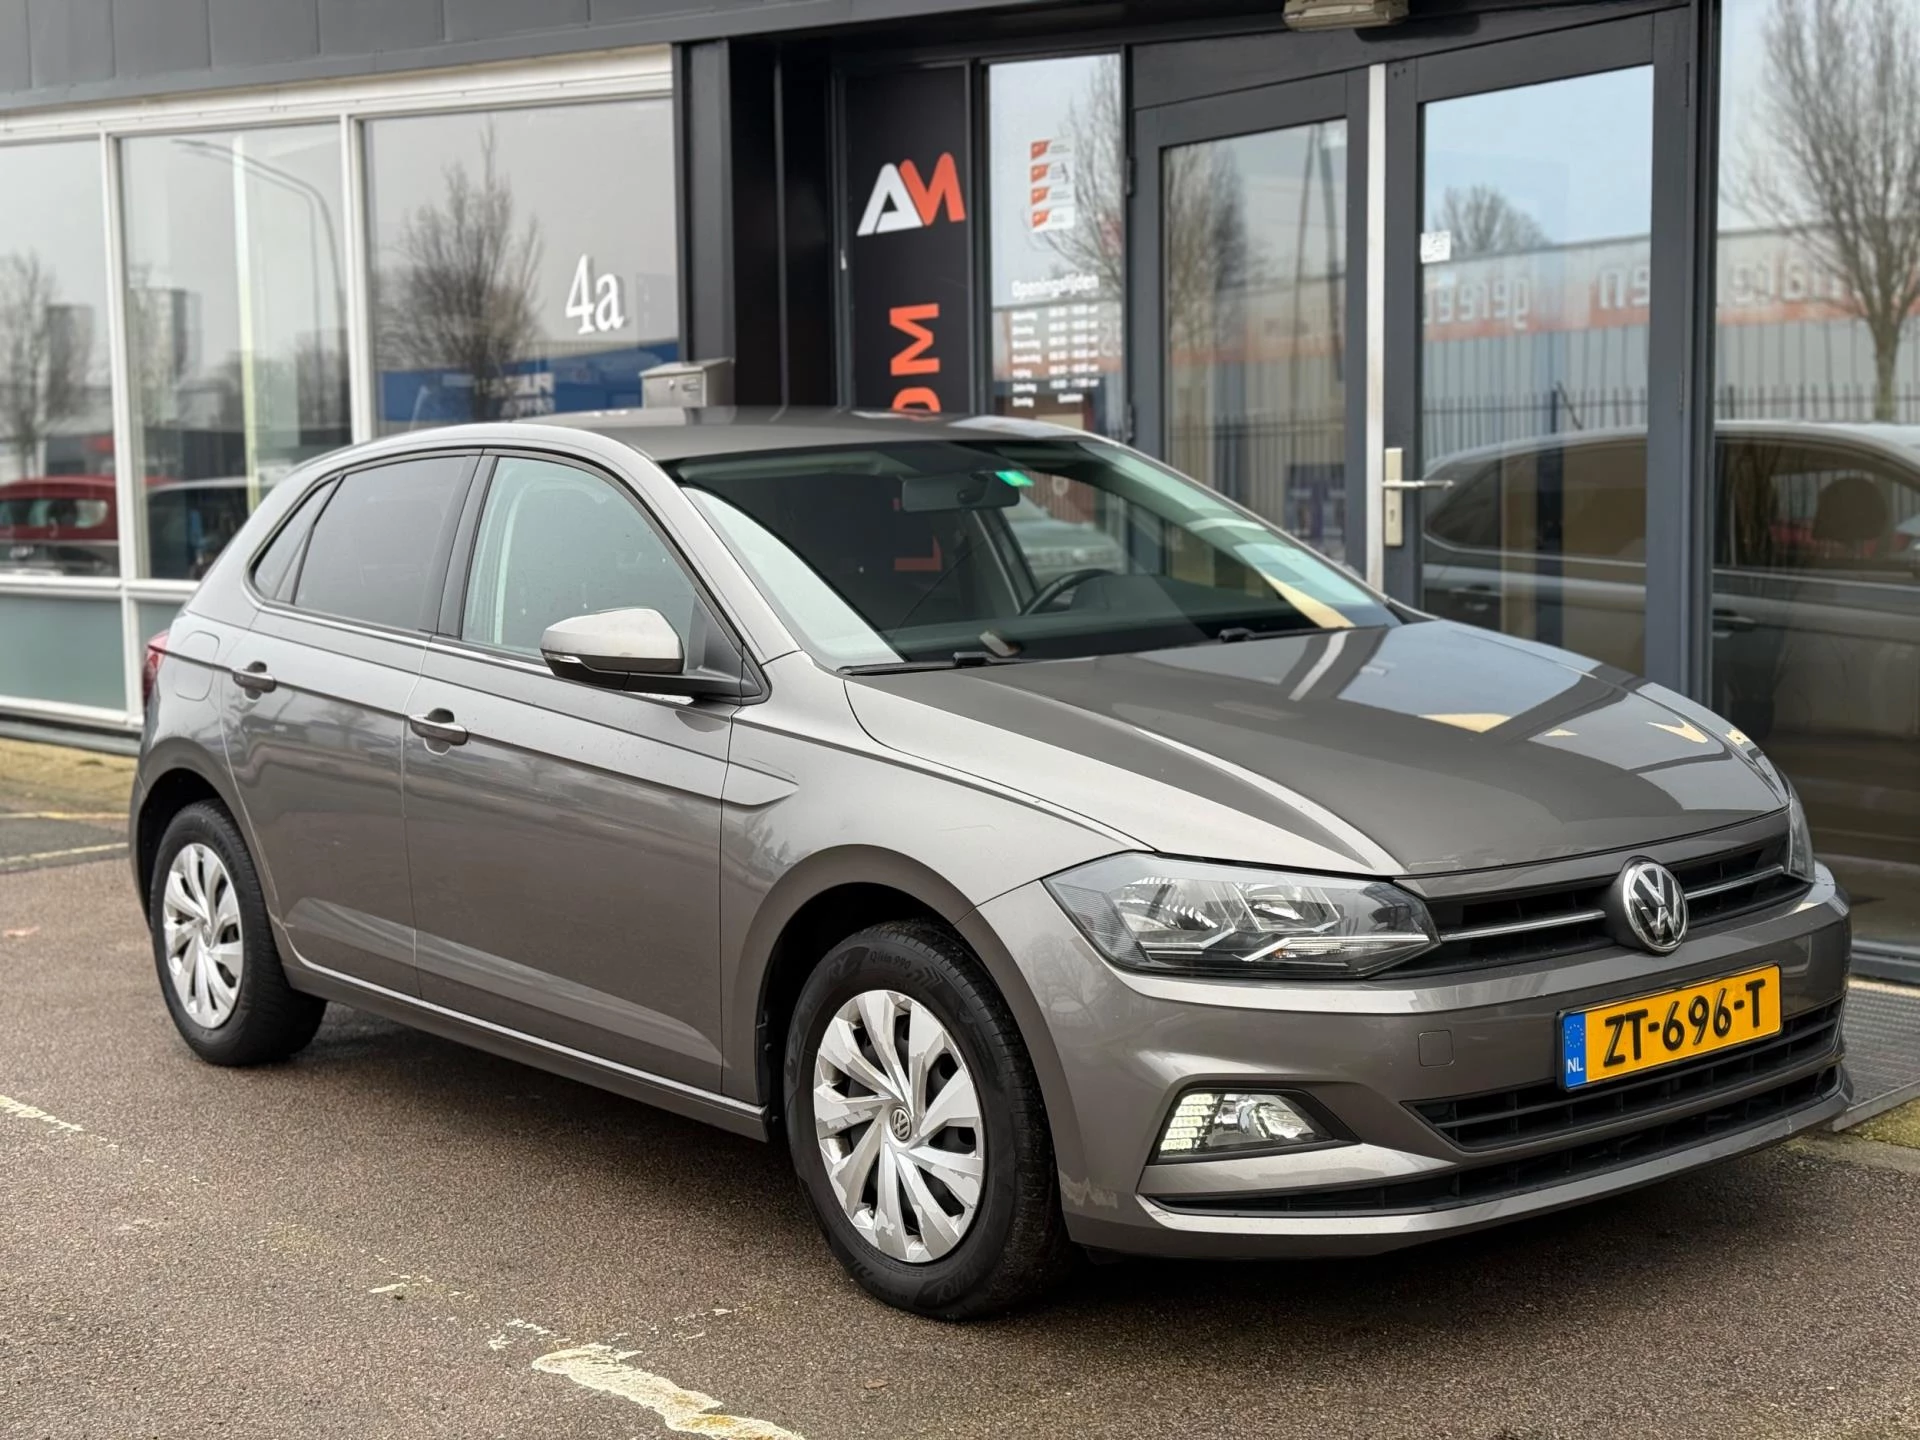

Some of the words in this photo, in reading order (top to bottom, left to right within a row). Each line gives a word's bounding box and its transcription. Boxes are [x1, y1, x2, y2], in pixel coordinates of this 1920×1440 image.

[856, 152, 966, 237] AM
[564, 254, 625, 335] 4a
[1603, 979, 1766, 1068] ZT-696-T
[1567, 1057, 1584, 1075] NL
